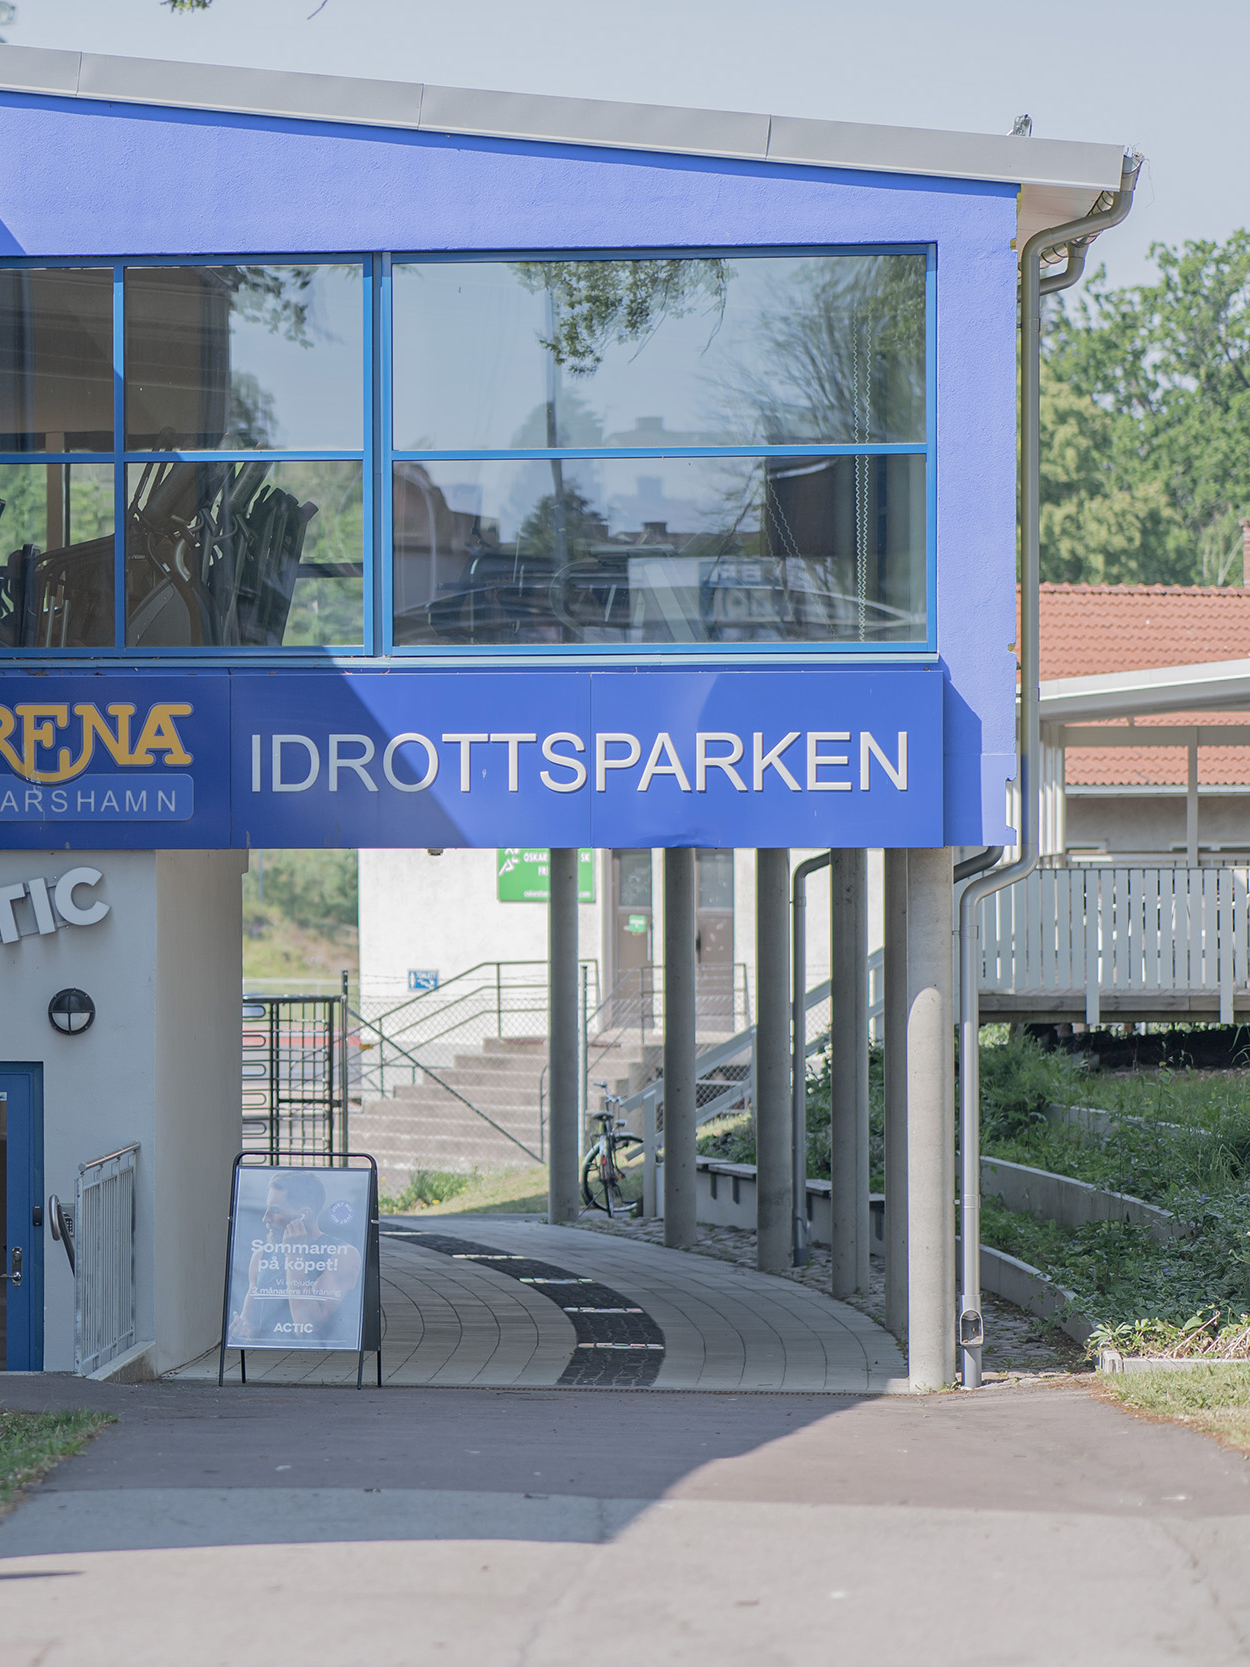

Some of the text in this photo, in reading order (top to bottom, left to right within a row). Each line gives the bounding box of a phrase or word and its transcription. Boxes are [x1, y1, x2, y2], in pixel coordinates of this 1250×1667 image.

[251, 730, 909, 793] IDROTTSPARKEN
[251, 1239, 348, 1255] Sommaren
[258, 1256, 338, 1274] på köpet!
[273, 1322, 314, 1333] ACTIC
